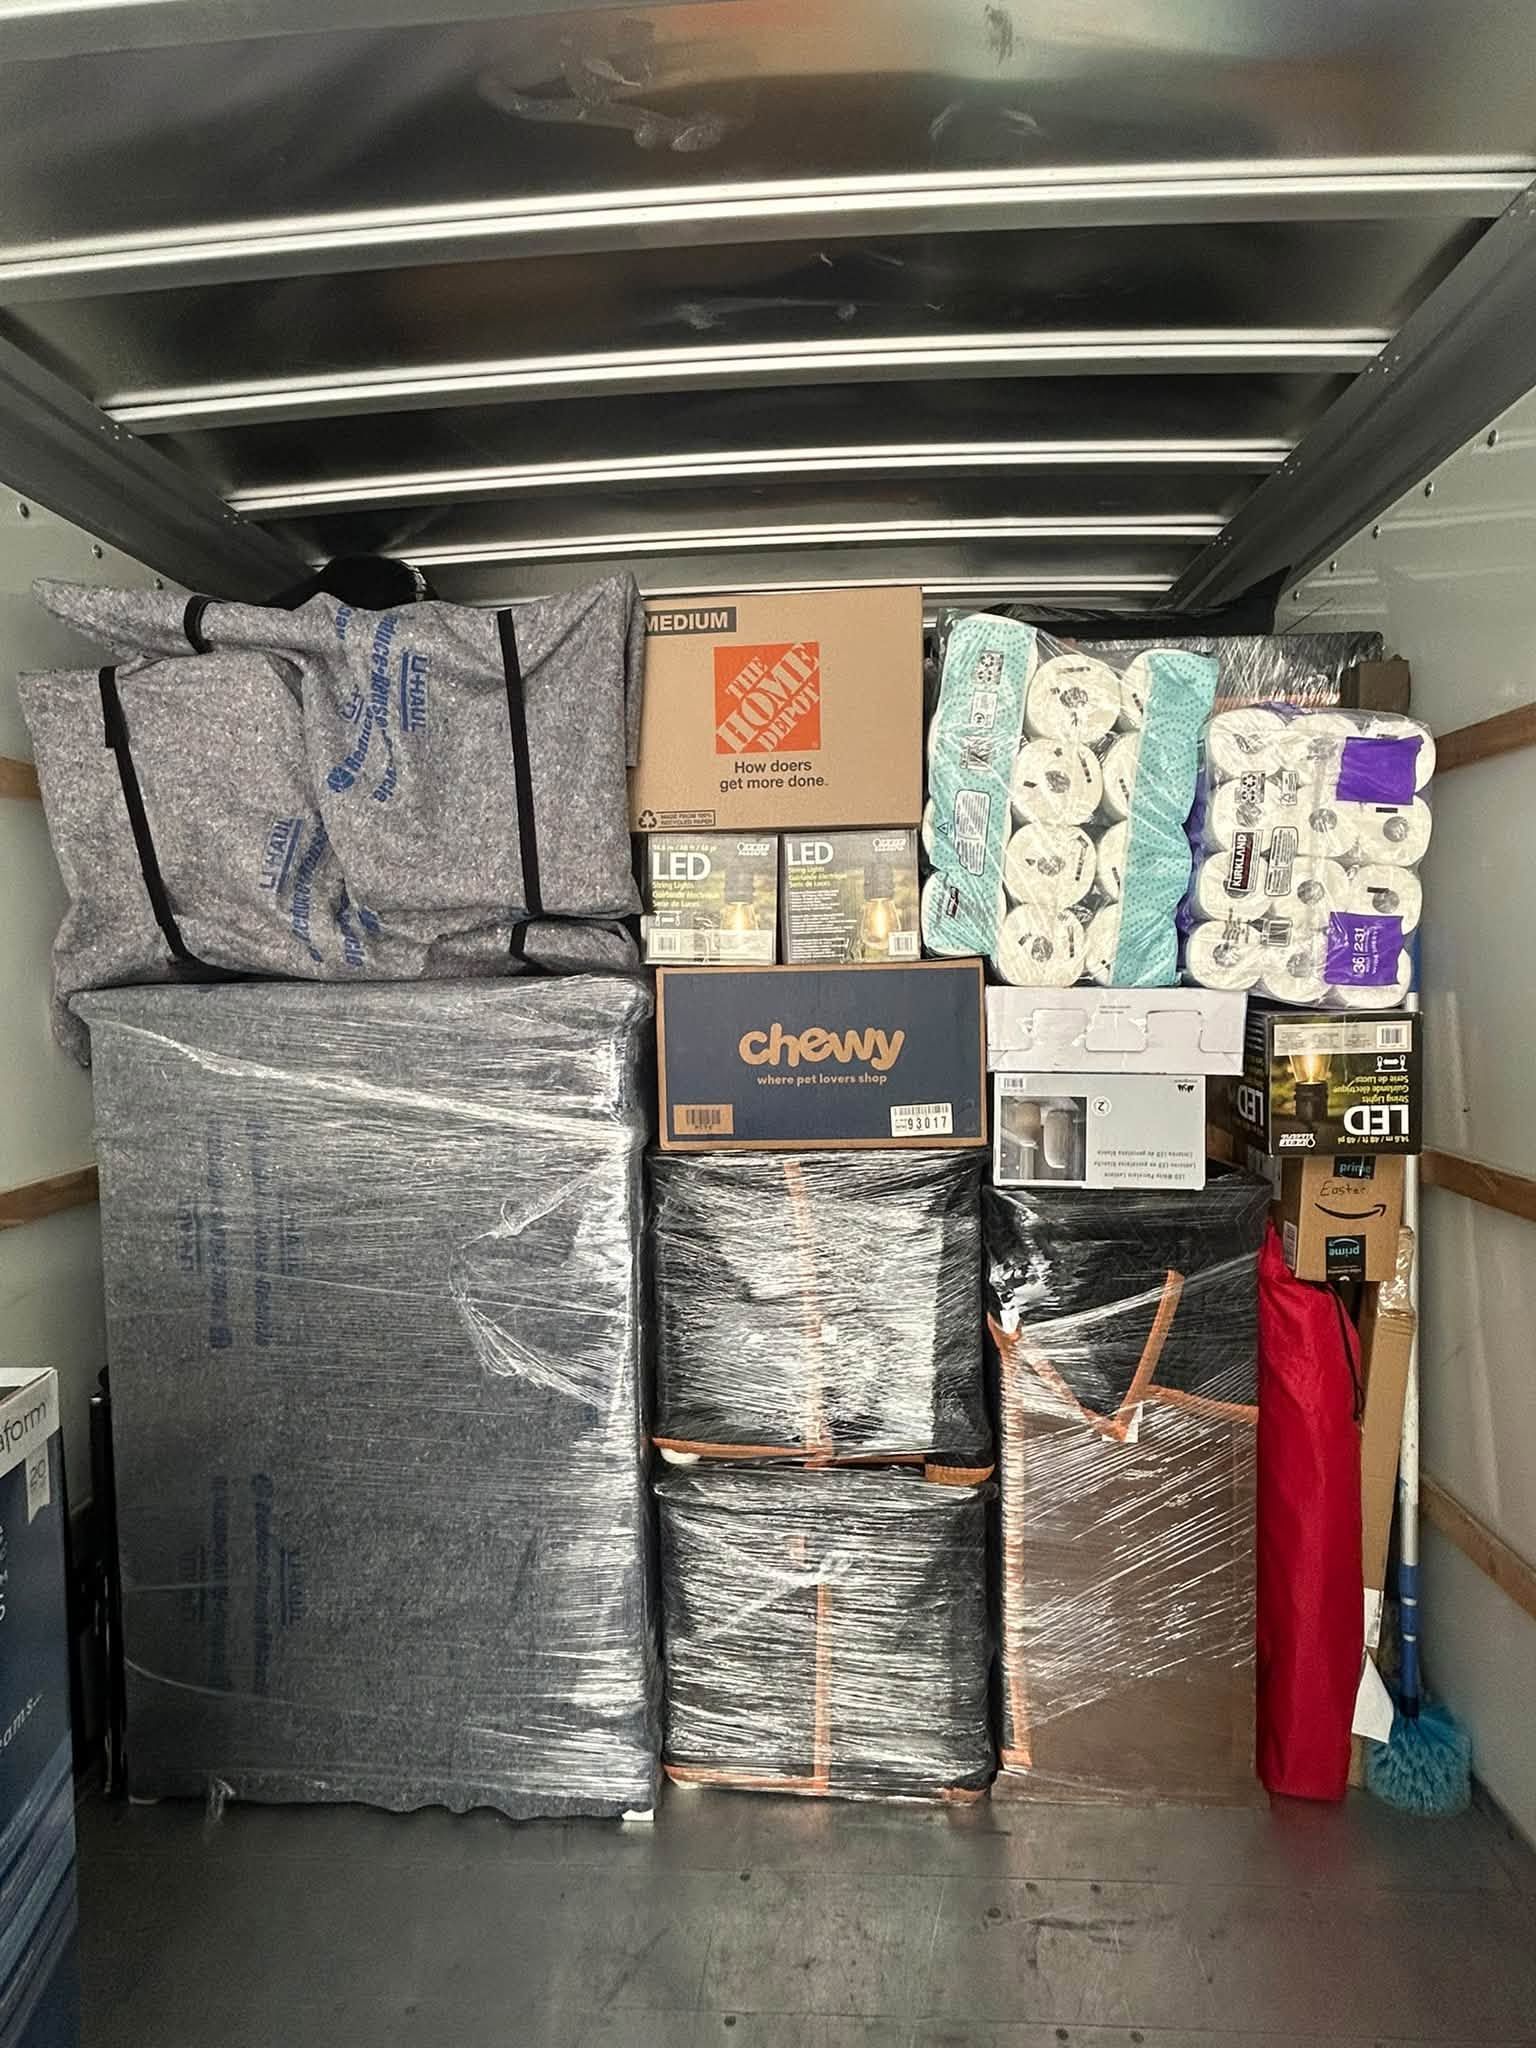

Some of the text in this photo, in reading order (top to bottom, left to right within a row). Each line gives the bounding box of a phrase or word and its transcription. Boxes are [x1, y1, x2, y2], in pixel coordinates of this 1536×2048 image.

[646, 611, 729, 632] MEDIUM
[725, 656, 768, 701] THE
[717, 643, 820, 752] HOME
[757, 682, 821, 752] DEPOT
[735, 760, 812, 773] How doers
[720, 777, 743, 793] get
[747, 777, 784, 789] more
[786, 841, 834, 866] LED
[1231, 833, 1248, 887] KIRKLAND
[652, 851, 712, 881] LED
[1354, 928, 1365, 952] 231
[1352, 956, 1365, 973] 36
[739, 1022, 905, 1071] chewy
[757, 1072, 887, 1087] where pet lovers shop
[1378, 1075, 1388, 1083] de
[1390, 1075, 1409, 1084] Serie
[1097, 1101, 1105, 1112] 2
[1238, 1085, 1264, 1127] LED
[1361, 1093, 1409, 1103] String Lights
[907, 1115, 947, 1130] 93017
[1343, 1104, 1409, 1135] LED
[1339, 1162, 1372, 1174] prime
[1320, 1180, 1368, 1197] Easter
[1328, 1245, 1361, 1258] prime
